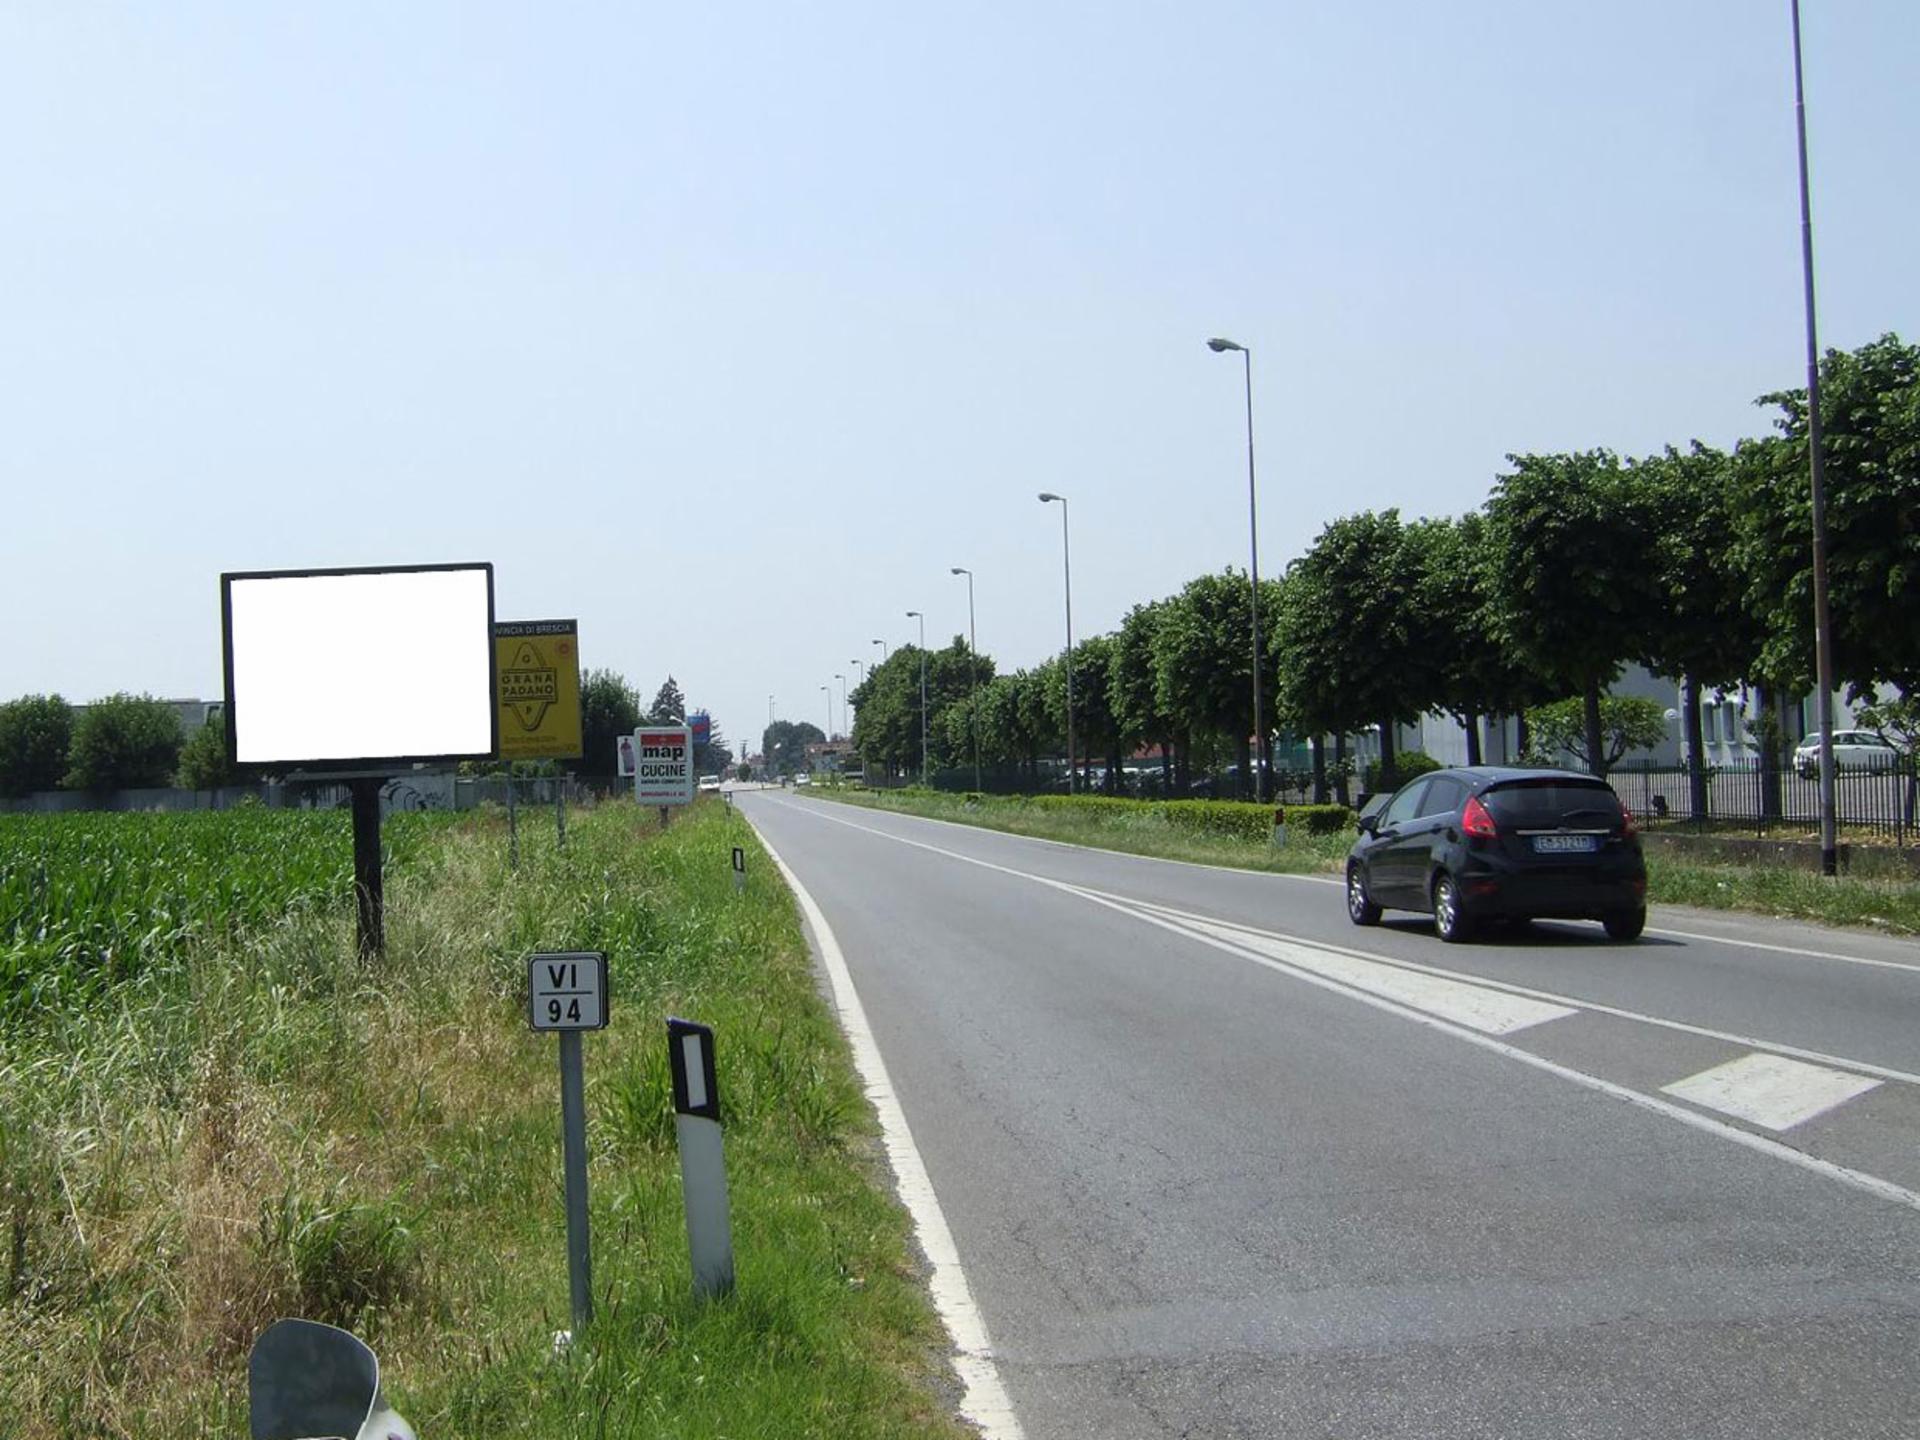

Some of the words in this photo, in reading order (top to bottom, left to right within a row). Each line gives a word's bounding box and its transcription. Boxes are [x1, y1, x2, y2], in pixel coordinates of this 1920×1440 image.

[535, 624, 570, 634] BRESCIA
[502, 674, 553, 685] GRANA
[502, 685, 554, 696] PADANO
[642, 747, 684, 761] map
[641, 764, 686, 777] CUCINE
[548, 964, 577, 989] VI
[548, 998, 581, 1023] 94
